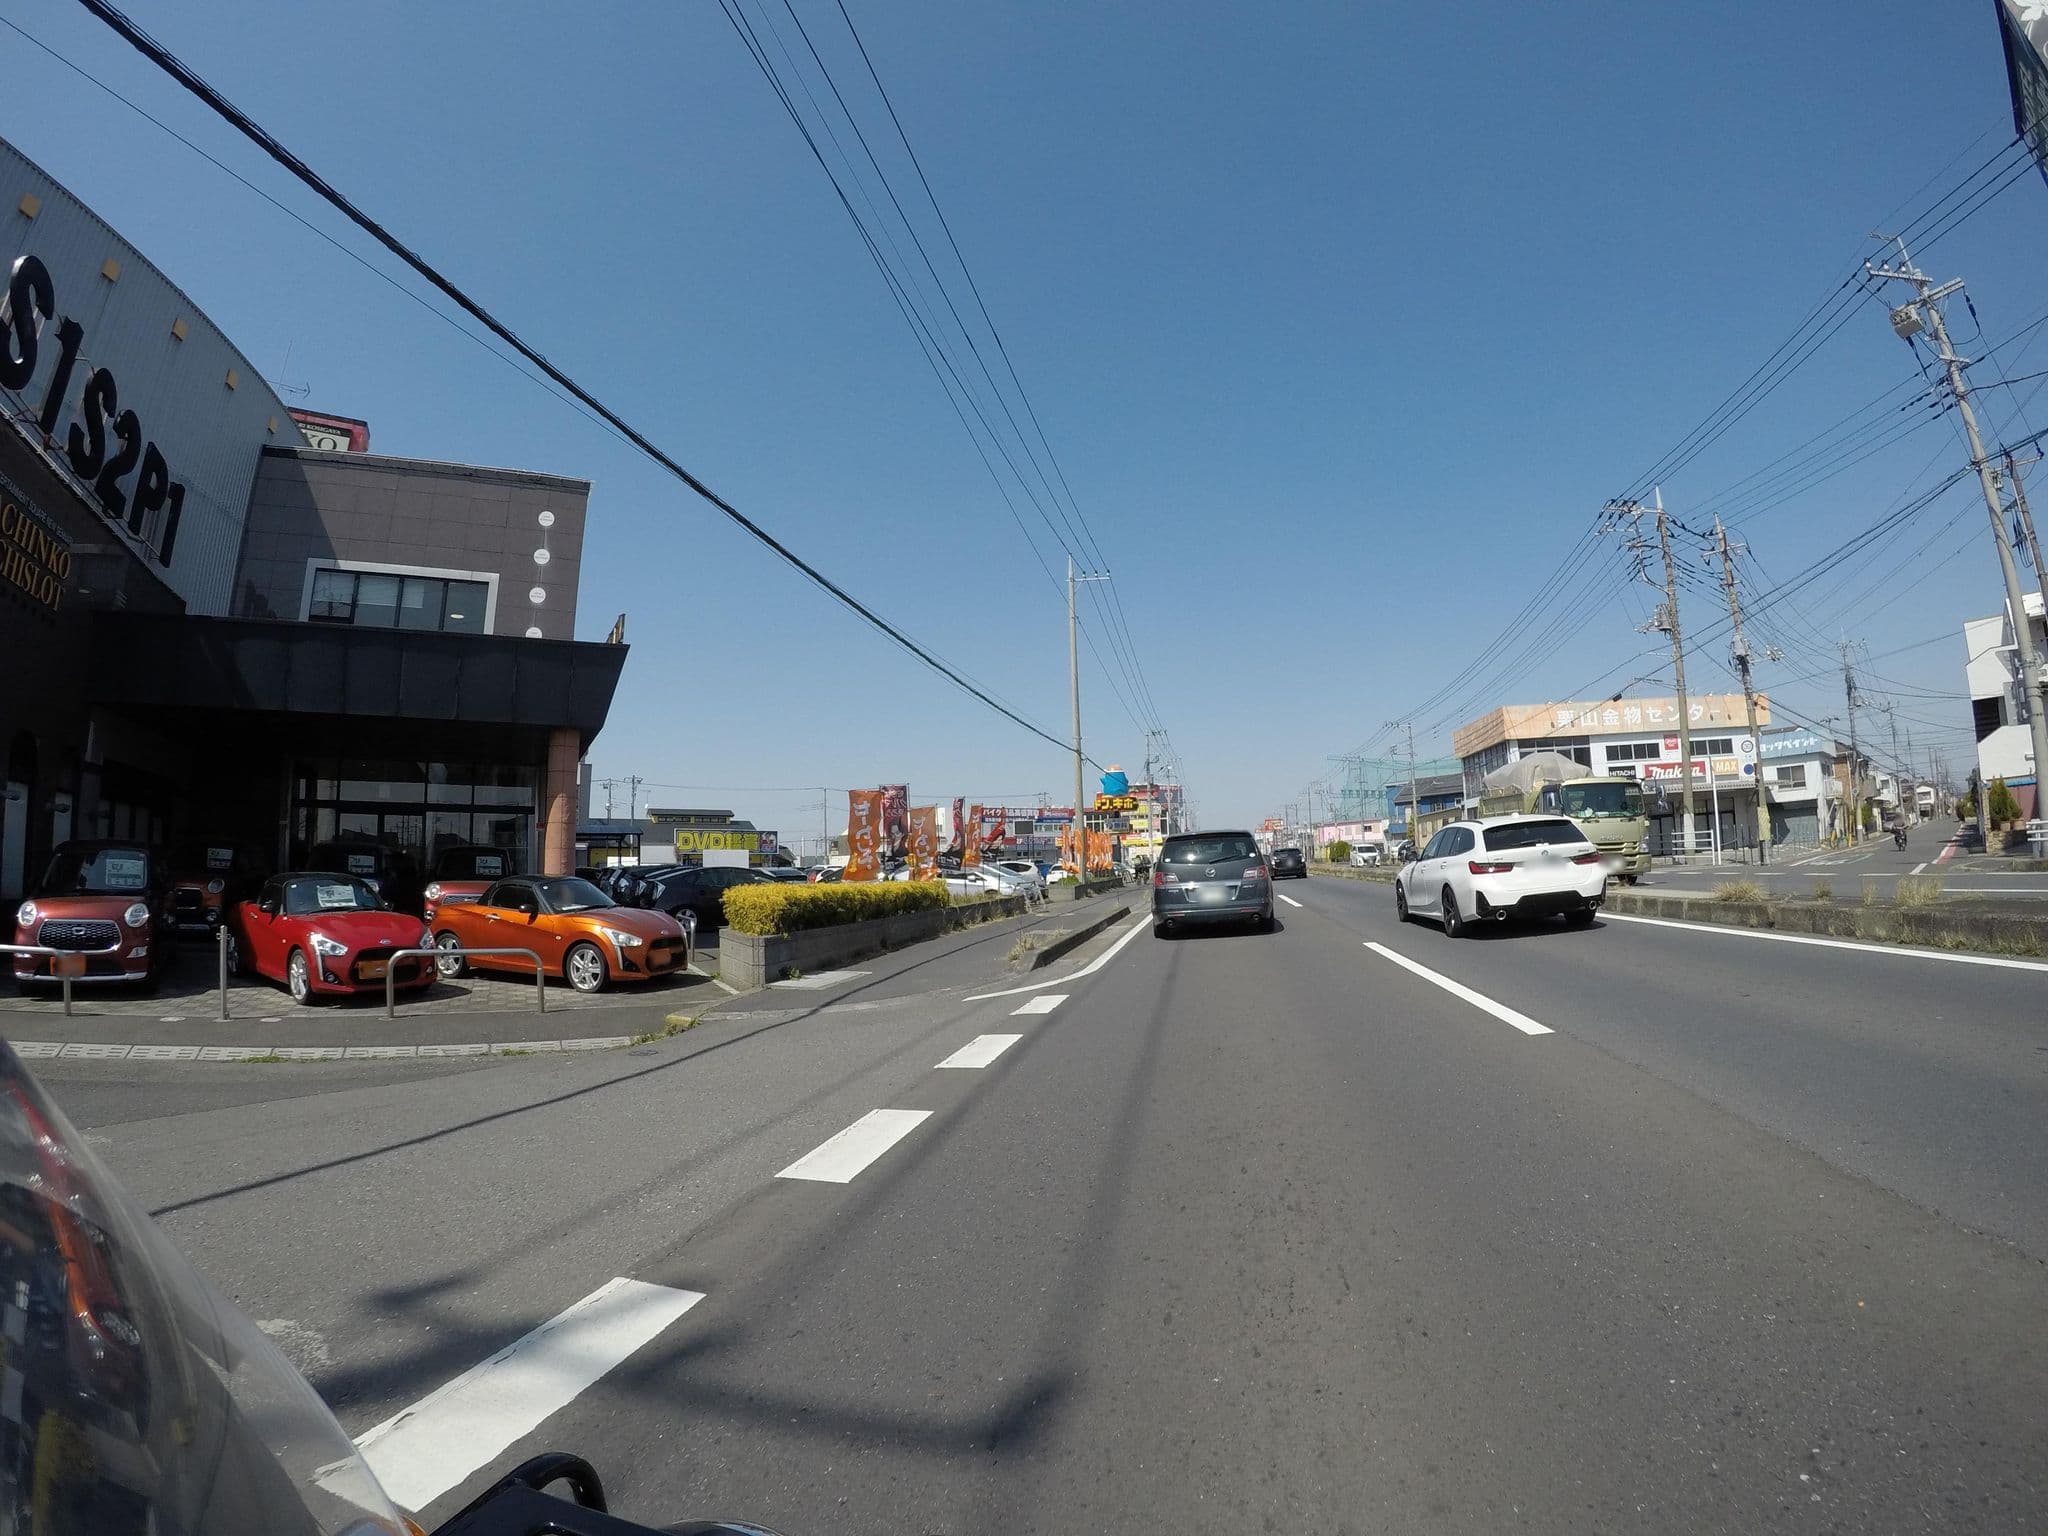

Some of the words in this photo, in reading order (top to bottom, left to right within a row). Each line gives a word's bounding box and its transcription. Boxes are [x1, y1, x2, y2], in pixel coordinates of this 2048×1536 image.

[0, 494, 71, 579] CHINKO
[1760, 737, 1817, 752] ロックペイント
[1609, 769, 1635, 777] HITACHI
[1716, 760, 1738, 773] MAX
